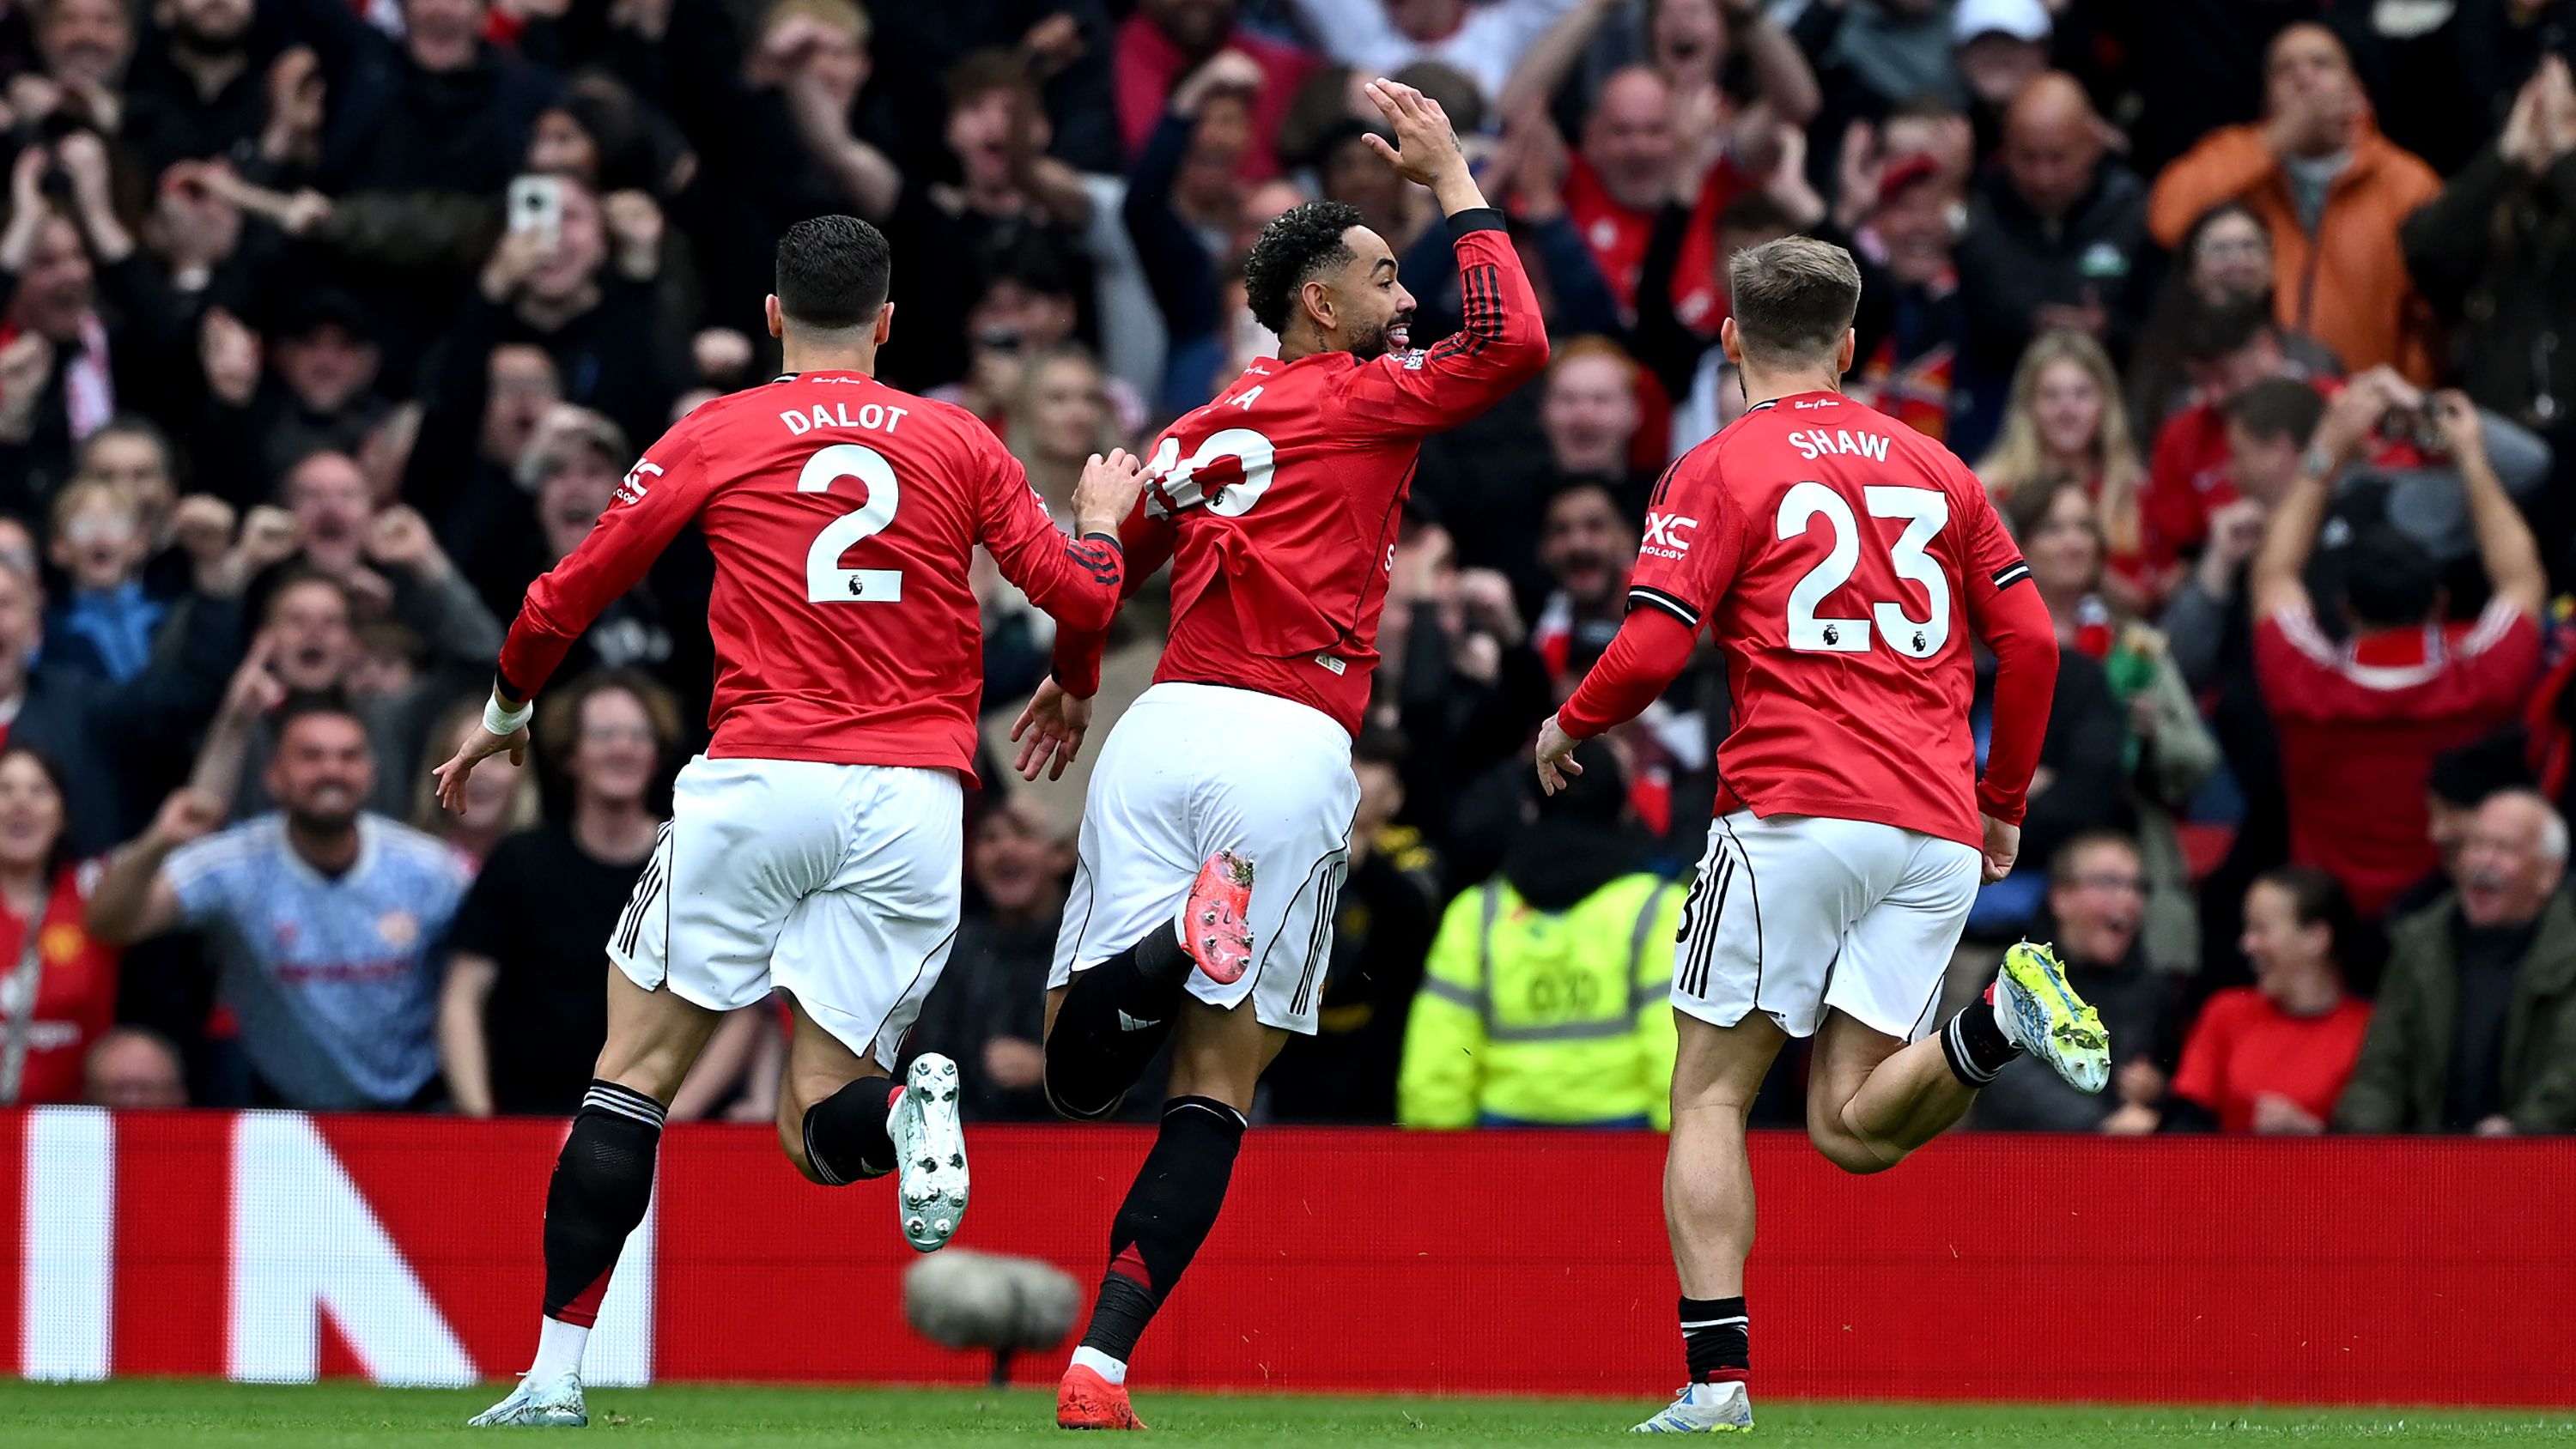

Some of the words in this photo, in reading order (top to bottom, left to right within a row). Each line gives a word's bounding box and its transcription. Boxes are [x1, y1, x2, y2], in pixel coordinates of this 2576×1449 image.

[779, 403, 908, 436] DALOT
[1788, 429, 1890, 463] SHAW
[797, 443, 902, 603] 2
[1642, 512, 1698, 551] XC
[1776, 481, 1950, 659] 23
